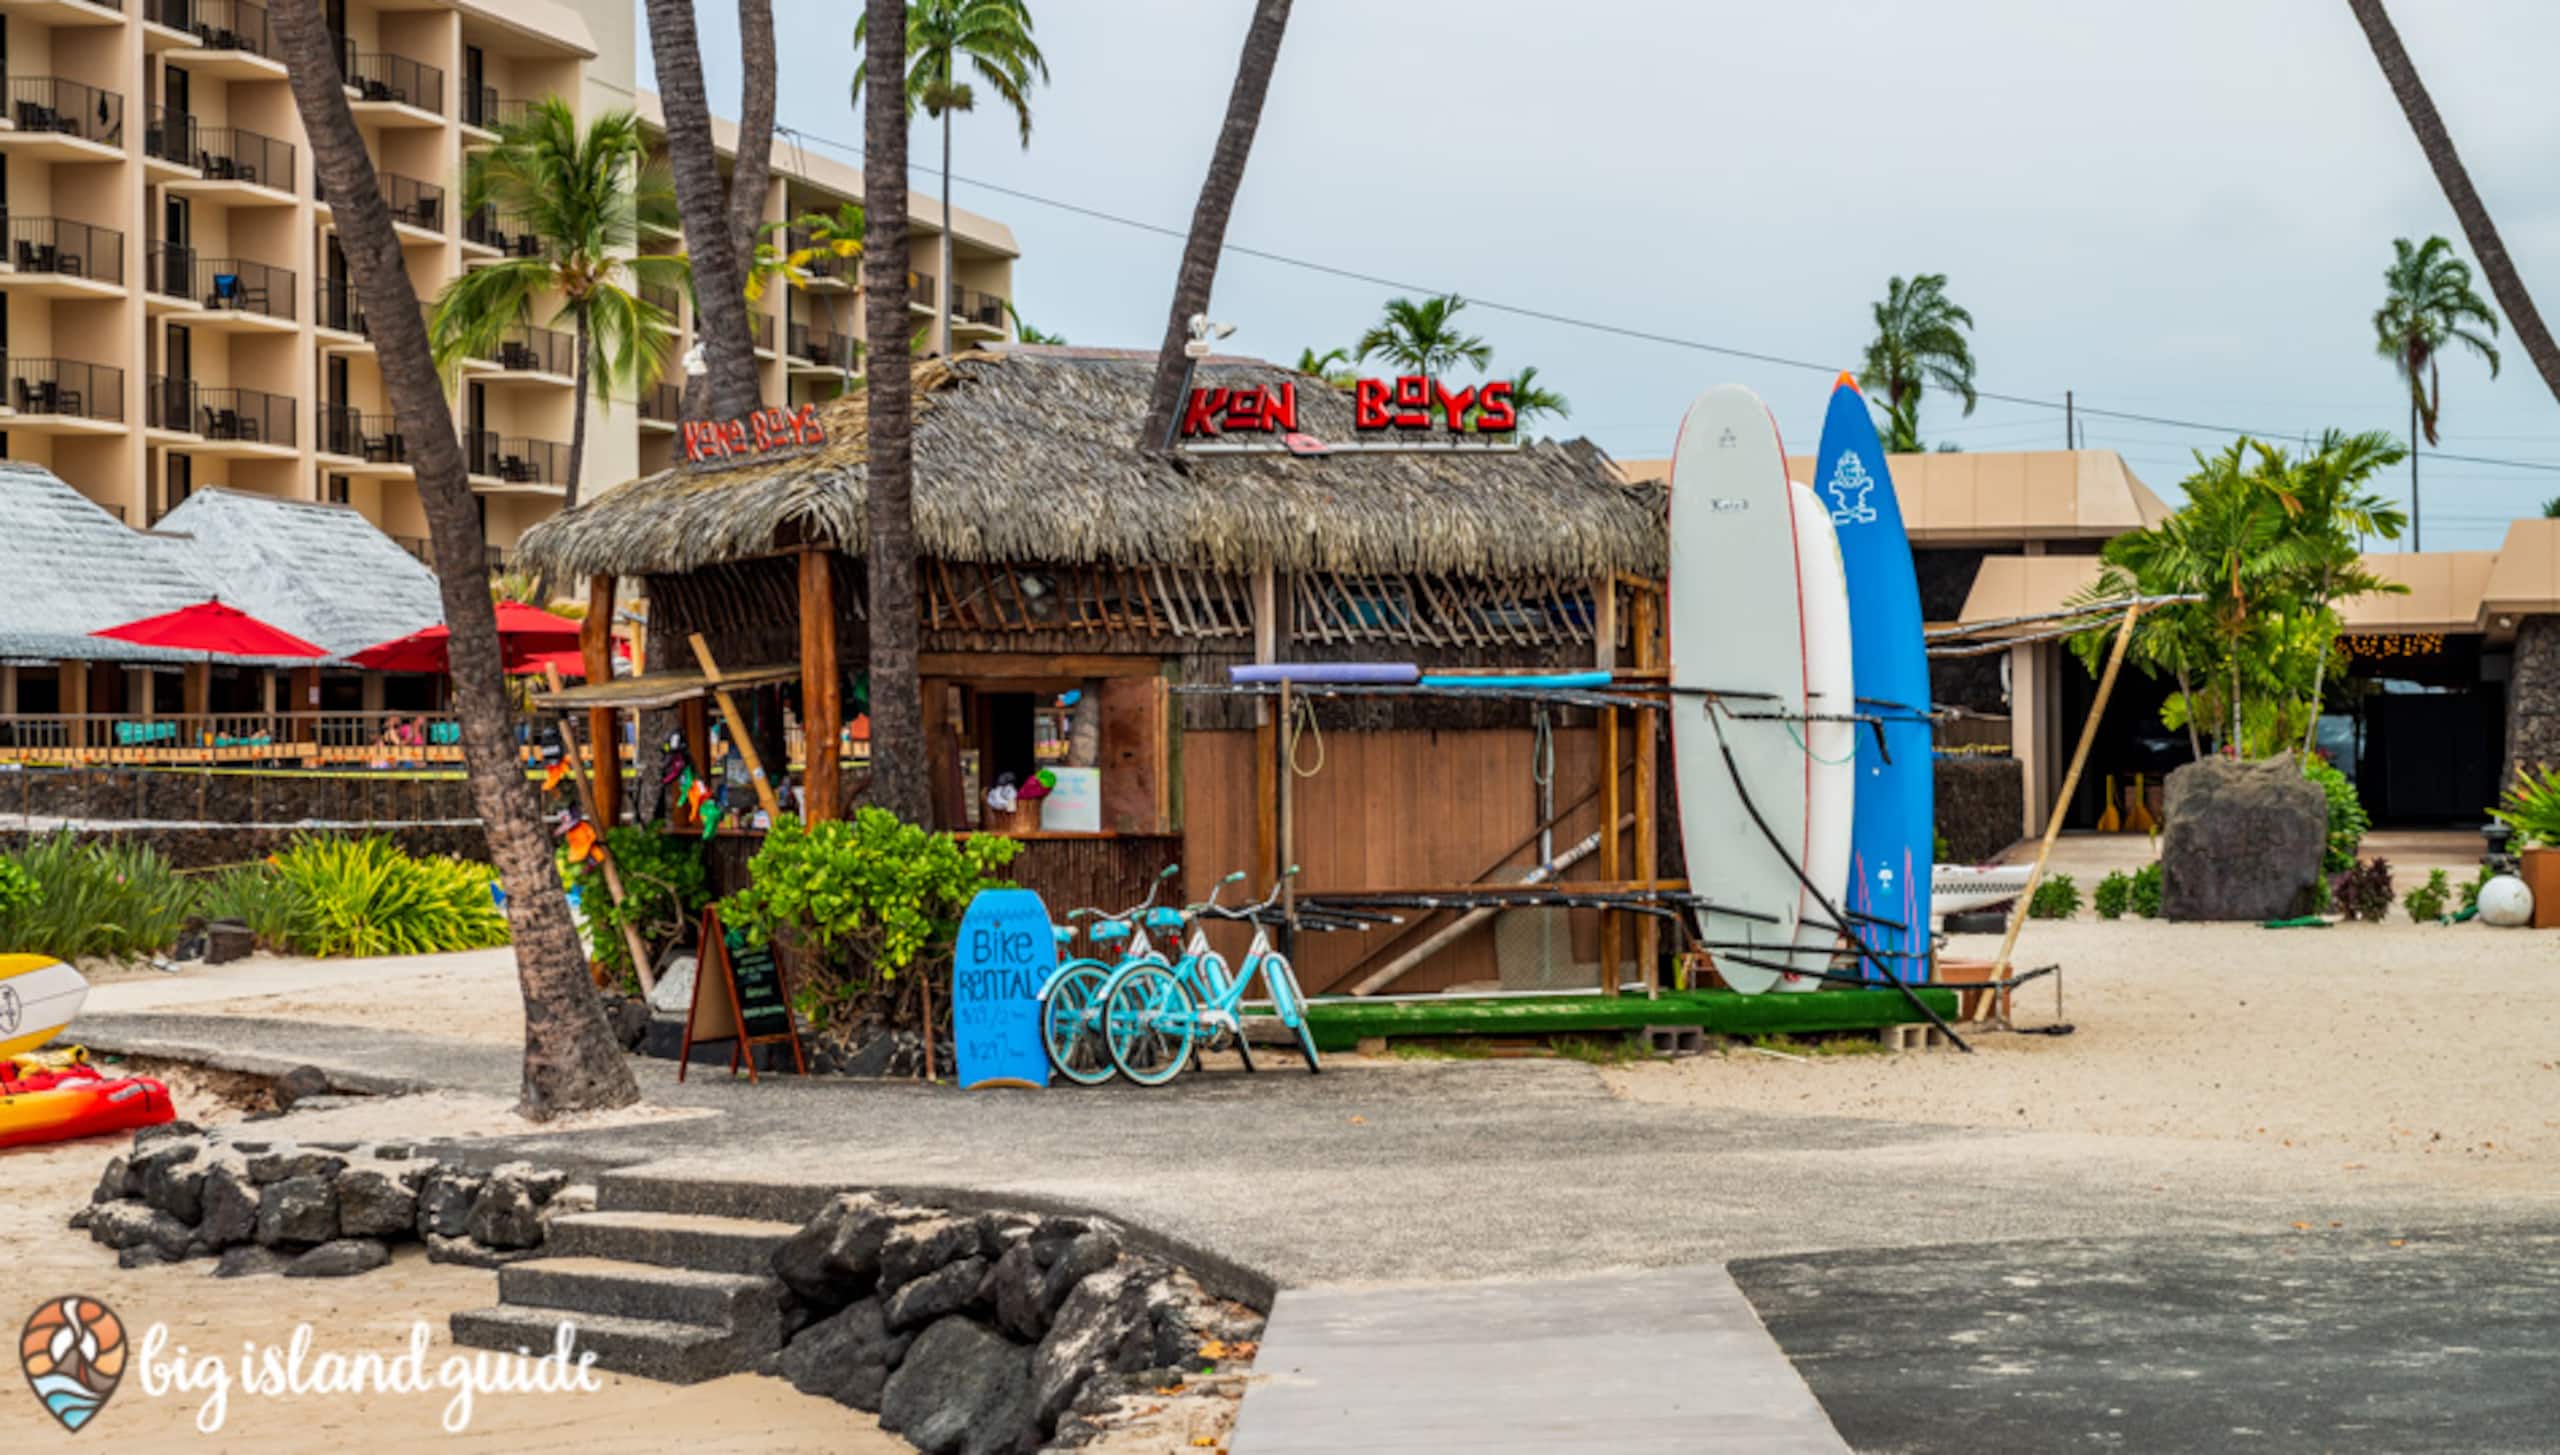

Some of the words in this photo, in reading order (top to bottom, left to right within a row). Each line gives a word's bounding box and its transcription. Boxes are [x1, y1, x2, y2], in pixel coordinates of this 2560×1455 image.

[683, 418, 748, 462] KONA
[751, 403, 825, 451] BOYS
[1355, 374, 1517, 433] BOYS
[973, 929, 1035, 964] Bike
